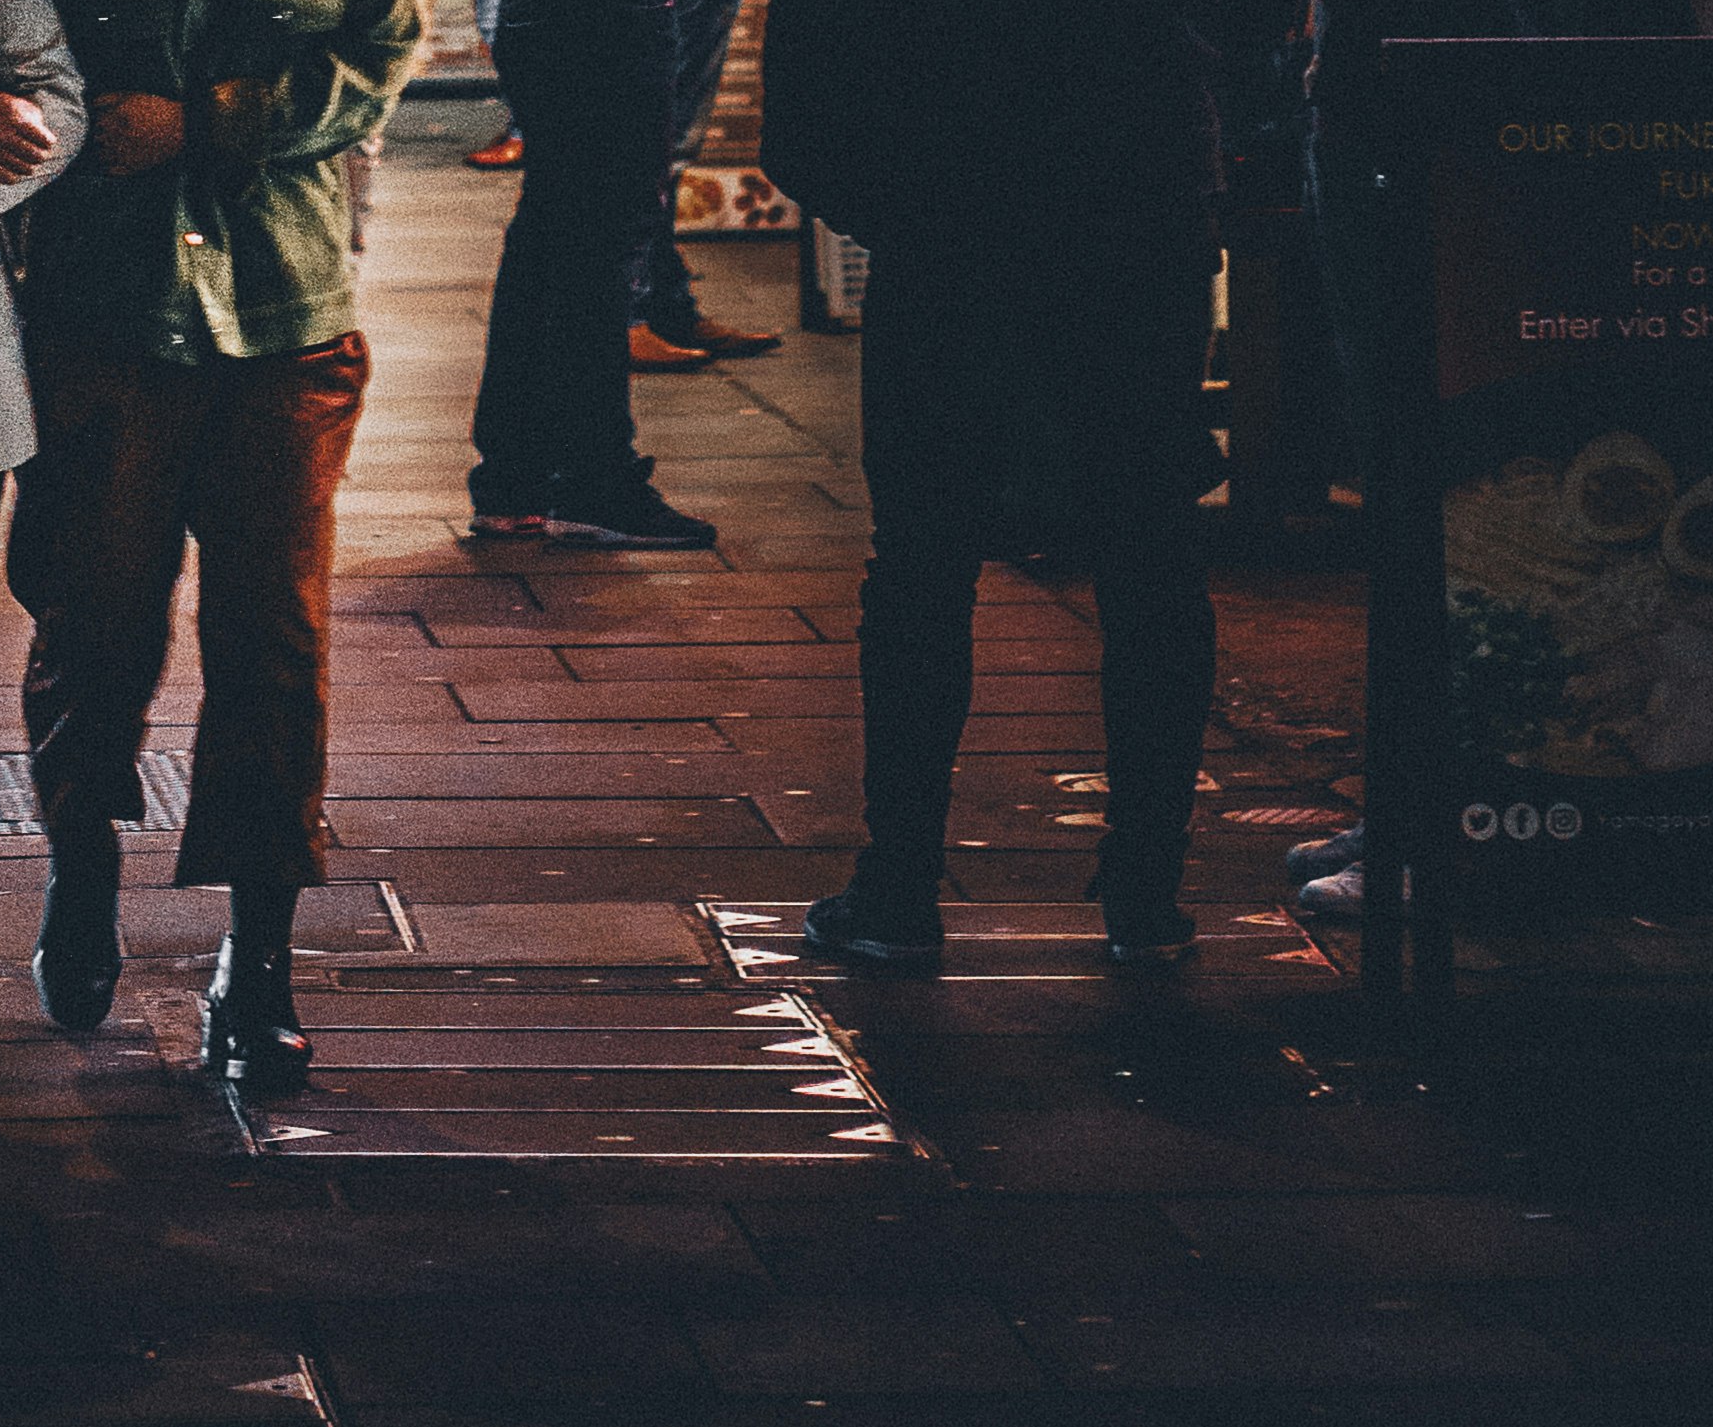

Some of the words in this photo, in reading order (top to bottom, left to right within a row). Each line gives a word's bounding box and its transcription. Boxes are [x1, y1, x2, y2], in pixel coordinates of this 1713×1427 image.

[1499, 122, 1572, 153] OUR
[1633, 260, 1676, 286] For
[1519, 309, 1602, 340] Enter
[1617, 307, 1666, 338] via
